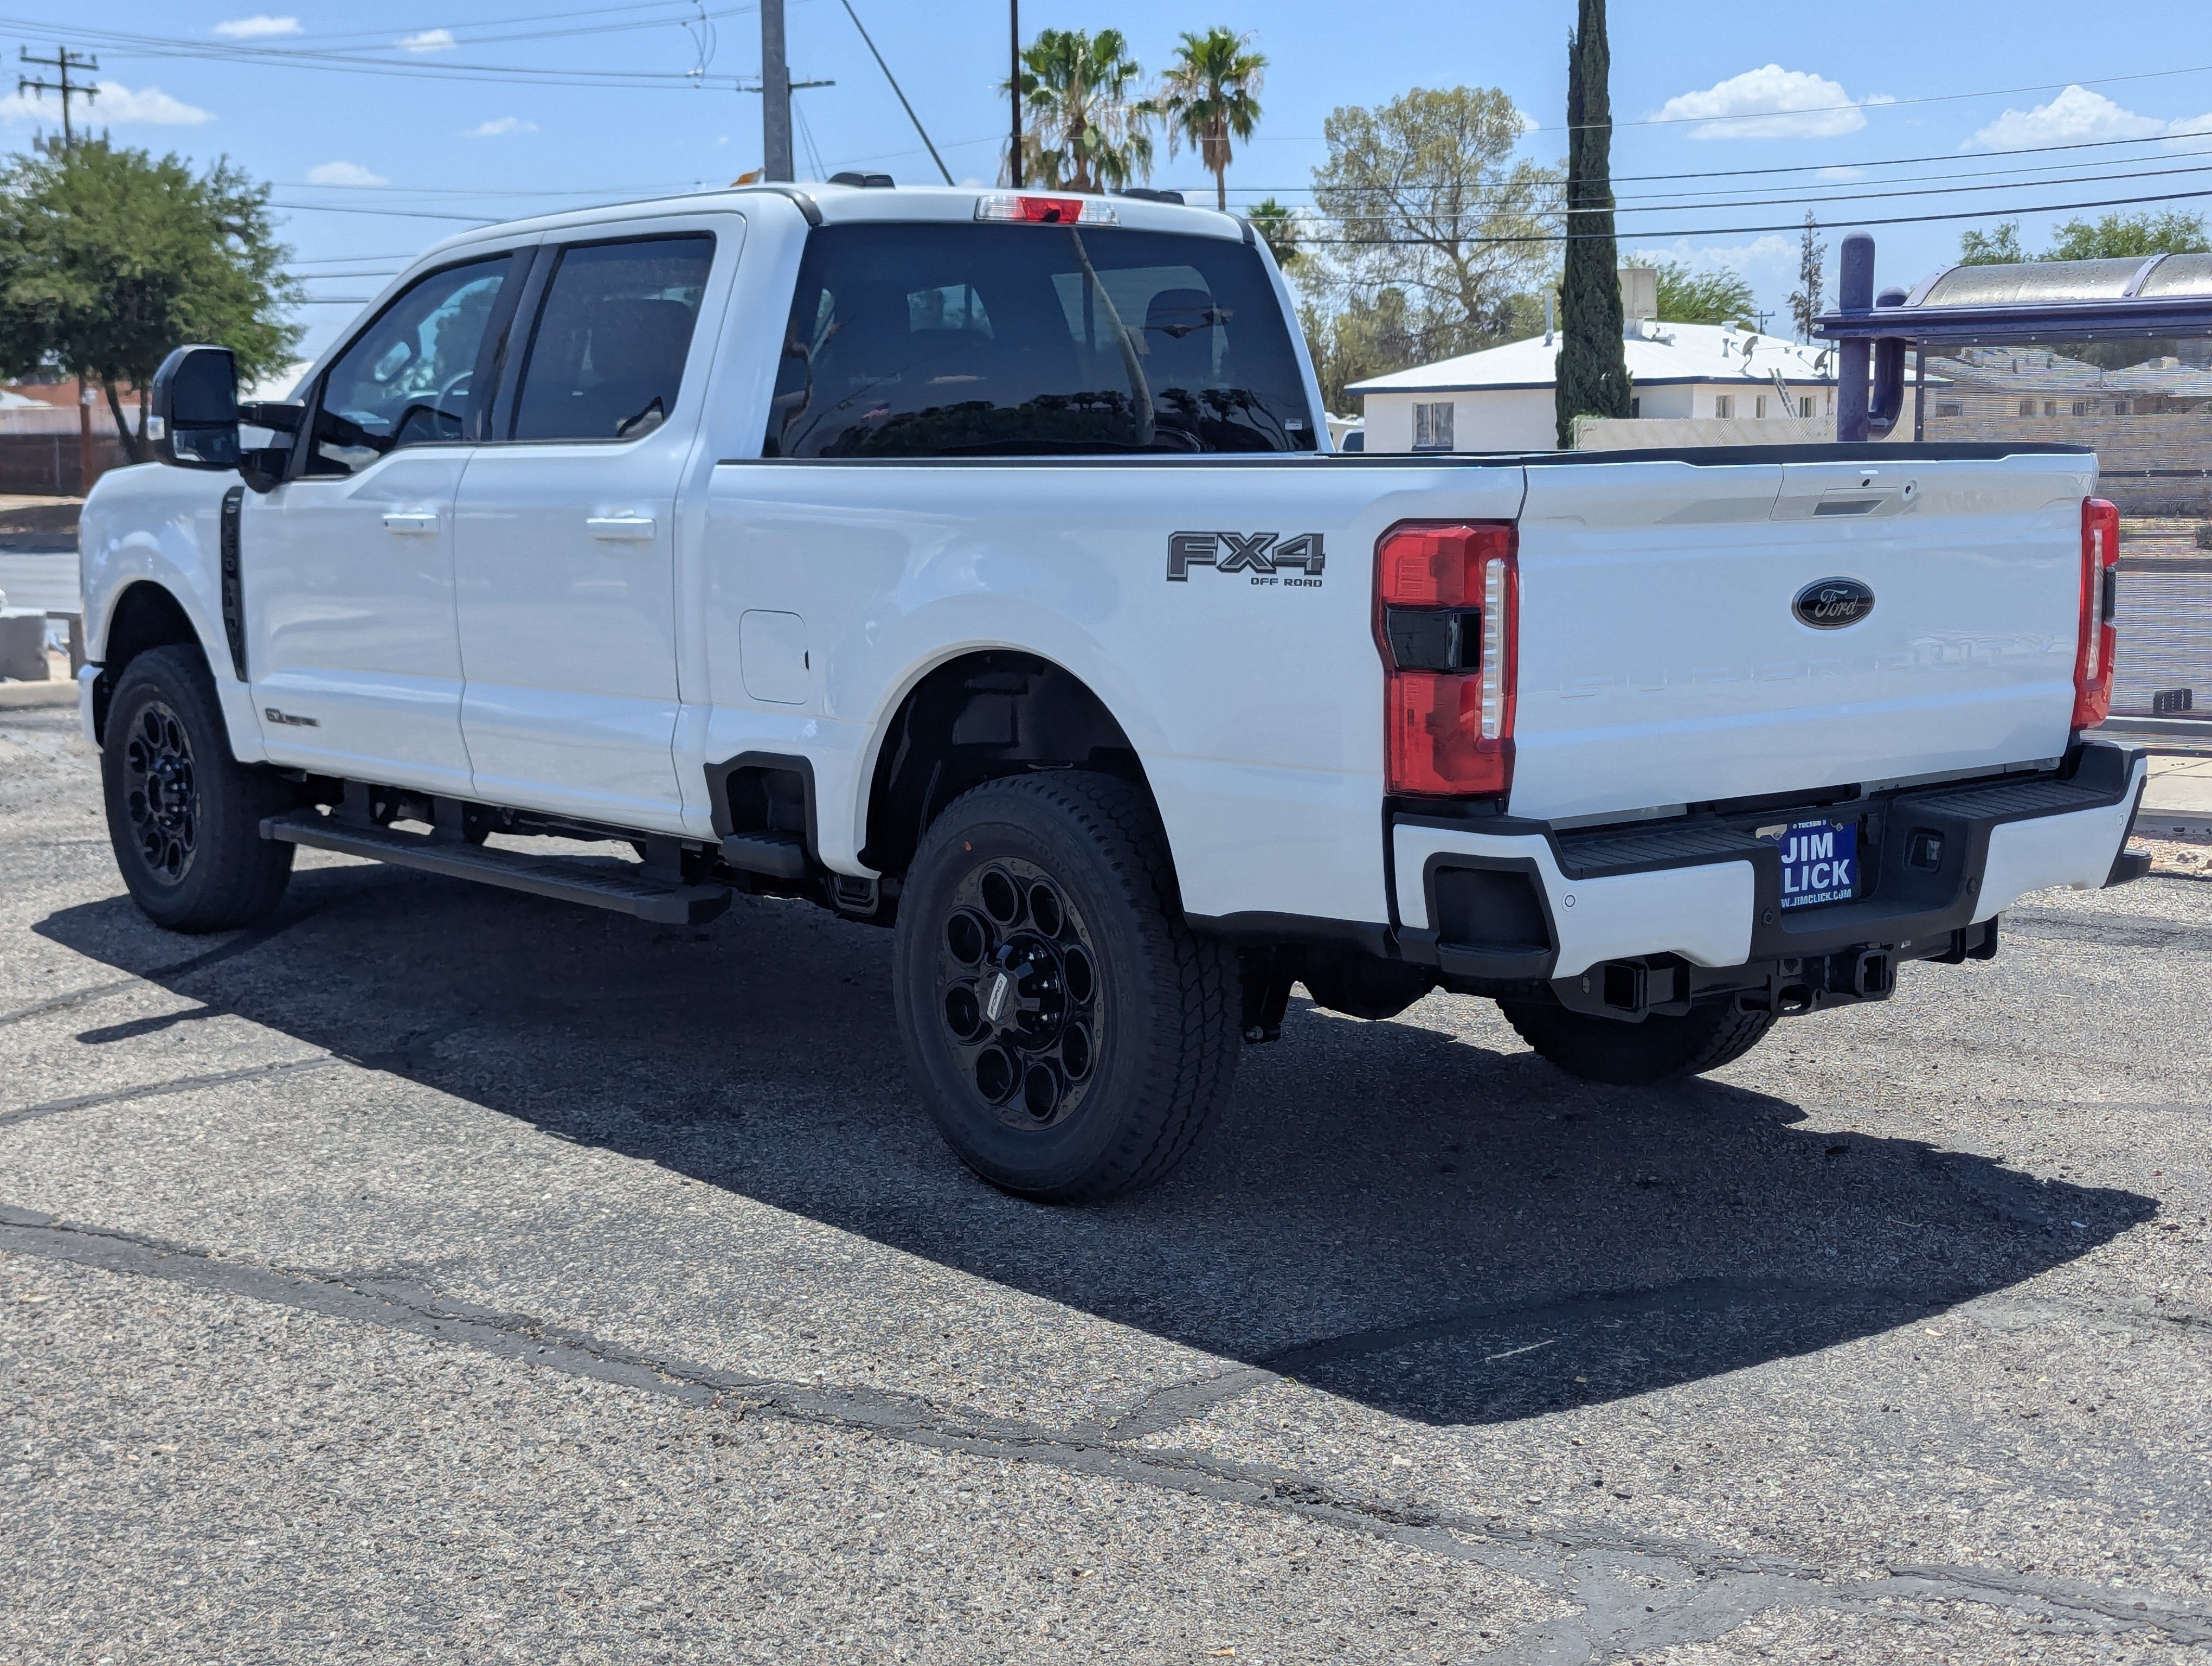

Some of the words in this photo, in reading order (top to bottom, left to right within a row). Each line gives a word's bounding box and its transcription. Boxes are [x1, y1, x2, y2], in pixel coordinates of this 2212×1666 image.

[1166, 530, 1326, 582] FX4
[1251, 578, 1278, 586] OFF
[1284, 578, 1322, 587] ROAD
[1815, 589, 1859, 618] Ford
[1781, 832, 1833, 864] JIM
[1784, 859, 1850, 893] LICK
[1780, 888, 1851, 908] W.JIMCLICK.COM
